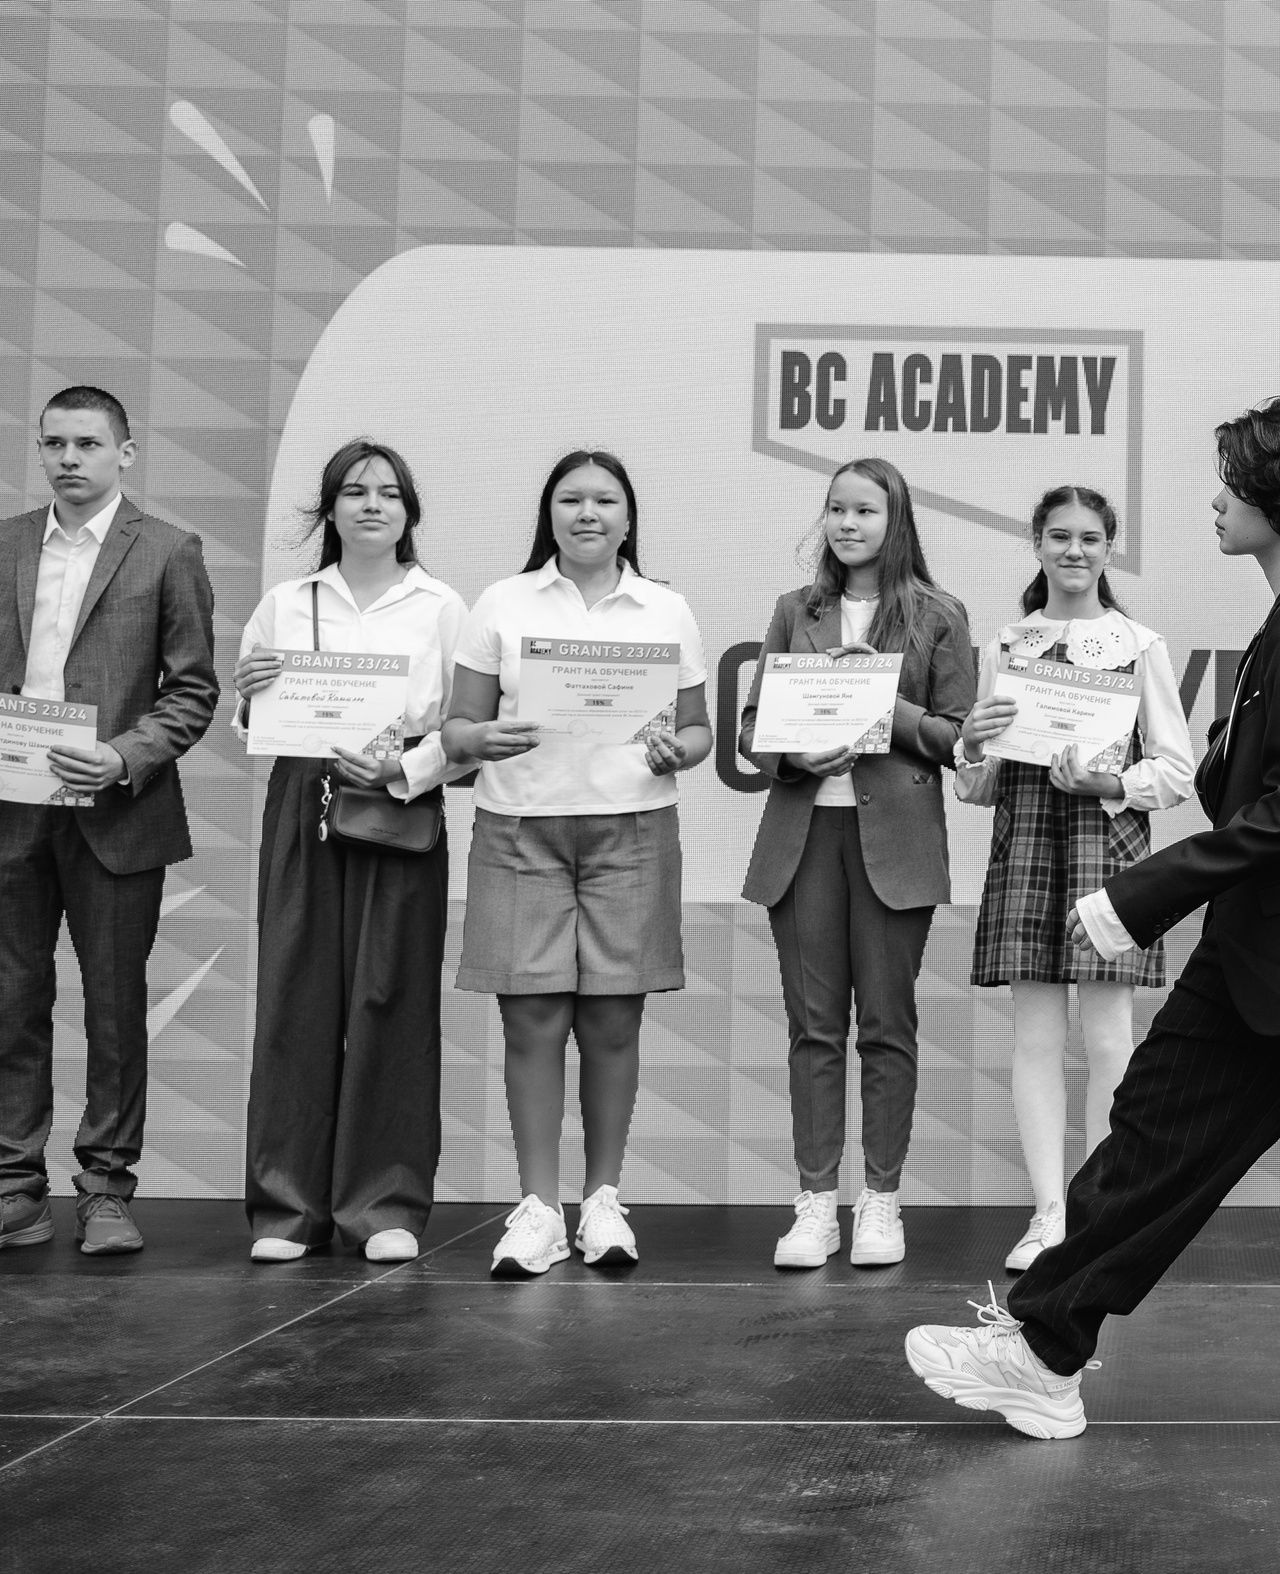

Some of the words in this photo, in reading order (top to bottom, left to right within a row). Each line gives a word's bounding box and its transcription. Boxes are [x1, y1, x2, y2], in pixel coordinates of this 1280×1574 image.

[779, 350, 847, 430] BC
[864, 352, 1117, 435] ACADEMY
[558, 643, 622, 658] GRANTS
[626, 646, 671, 659] 23/24
[291, 654, 353, 669] GRANTS
[356, 657, 401, 672] 23/24
[551, 665, 583, 675] ГРАНТ
[584, 667, 598, 676] НА
[600, 668, 648, 677] ОБУЧЕНИЕ
[796, 657, 851, 669] GRANTS
[853, 657, 894, 669] 23/24
[284, 676, 314, 686] ГРАНТ
[315, 678, 328, 687] НА
[330, 679, 377, 689] ОБУЧЕНИЕ
[788, 678, 815, 686] ГРАНТ
[816, 678, 828, 686] НА
[829, 678, 872, 686] ОБУЧЕНИЕ
[1033, 662, 1091, 684] GRANTS
[1094, 673, 1135, 691] 23/24
[564, 682, 607, 691] Фаттаховой
[607, 683, 634, 692] Сафине
[1024, 683, 1053, 697] ГРАНТ
[1054, 689, 1066, 699] НА
[1068, 691, 1112, 706] ОБУЧЕНИЕ
[42, 703, 88, 721] 23/24
[1, 720, 14, 730] НА
[15, 723, 64, 737] ОБУЧЕНИЕ
